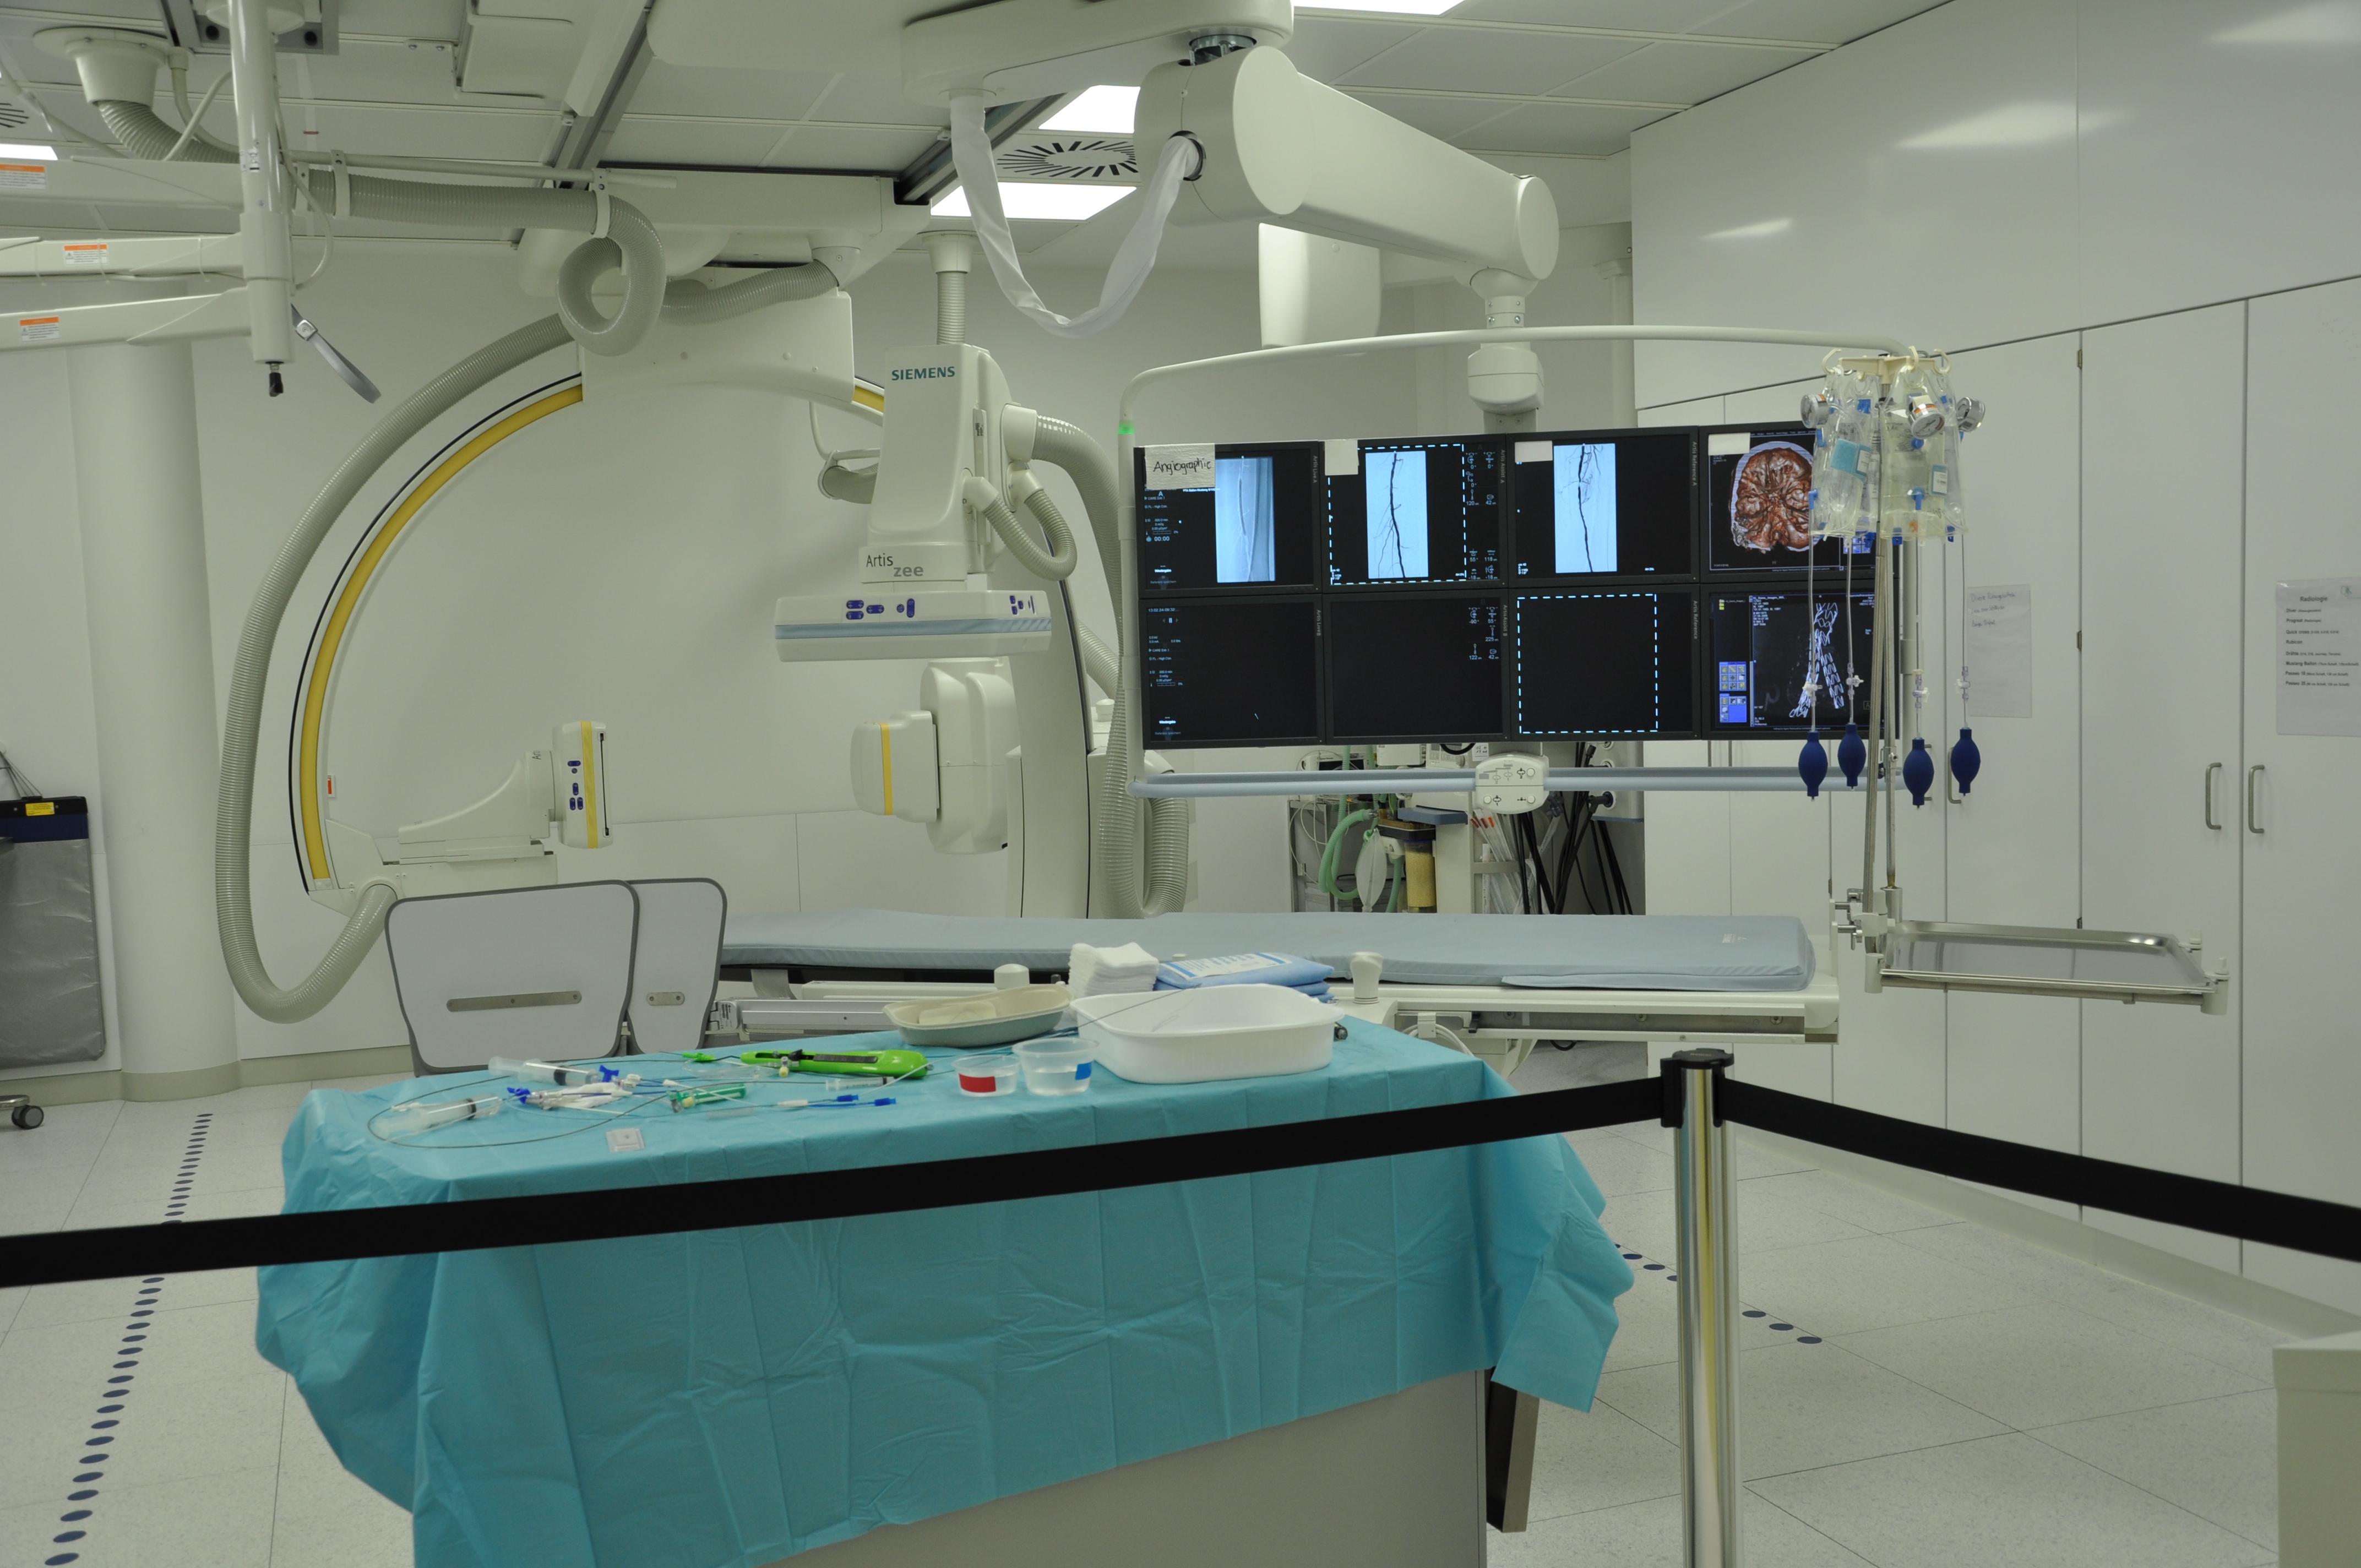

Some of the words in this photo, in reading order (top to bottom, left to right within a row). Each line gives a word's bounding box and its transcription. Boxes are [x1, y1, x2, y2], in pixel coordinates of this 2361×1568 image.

[891, 366, 955, 381] SIEMENS
[1153, 458, 1211, 475] Angiographic
[866, 553, 893, 567] Artis
[894, 566, 923, 577] zee
